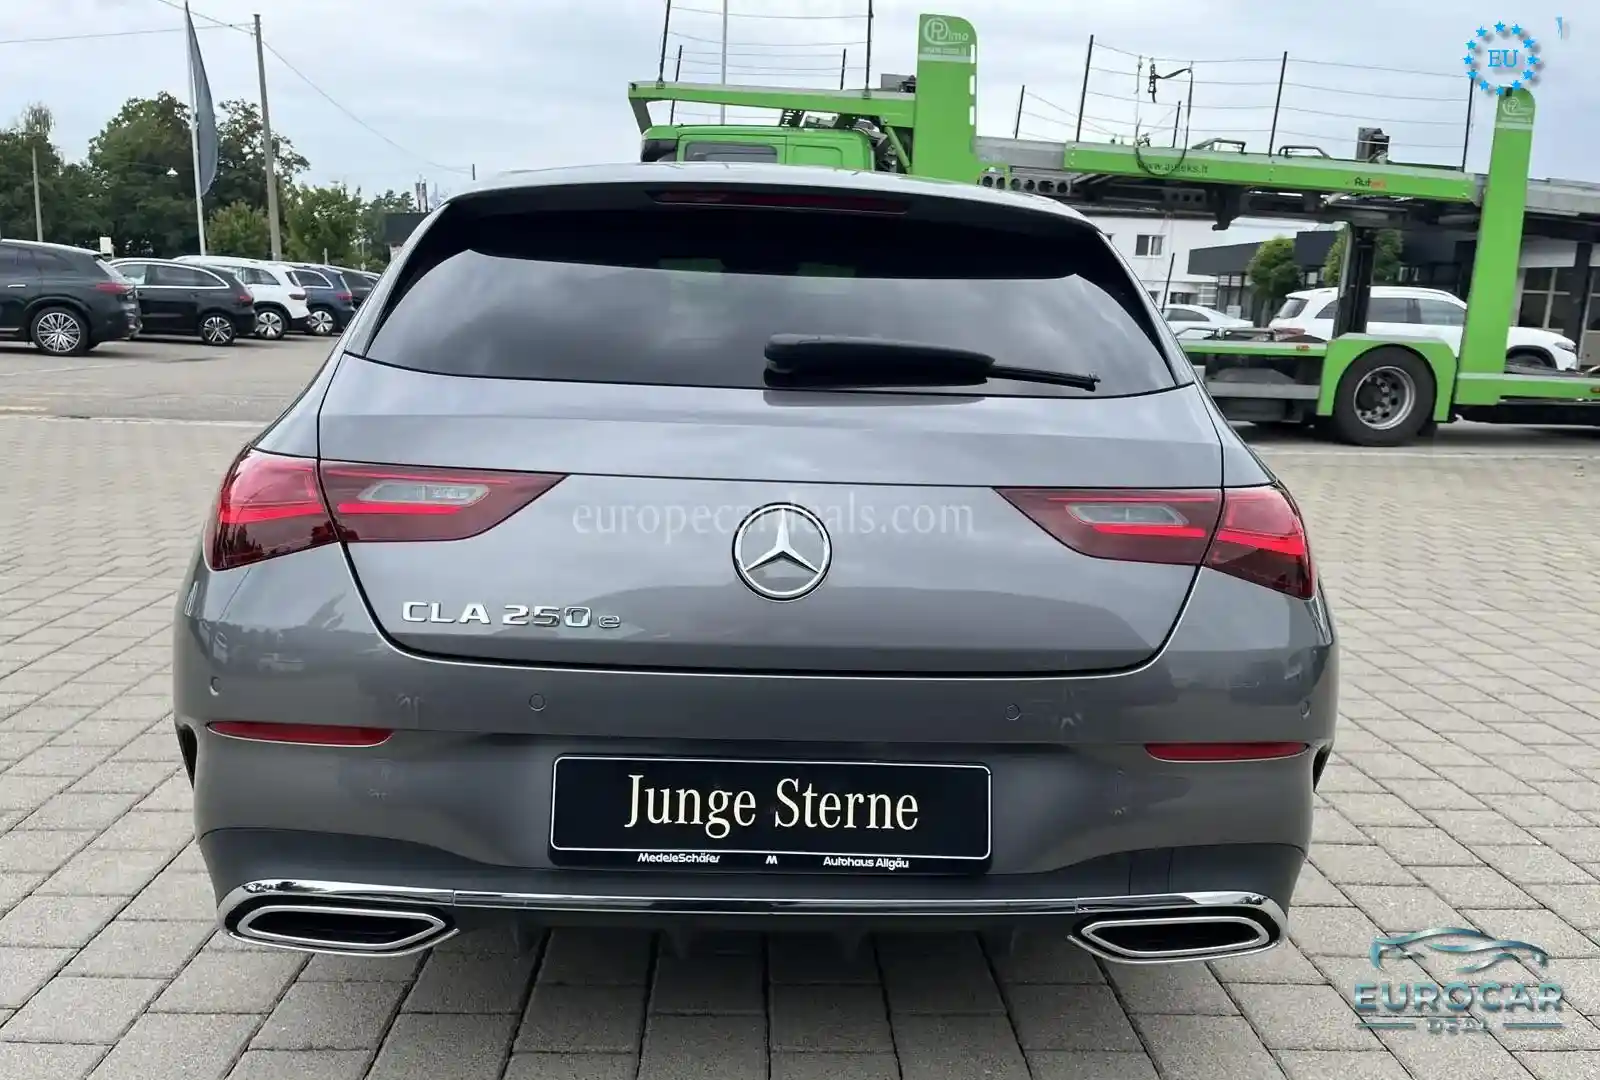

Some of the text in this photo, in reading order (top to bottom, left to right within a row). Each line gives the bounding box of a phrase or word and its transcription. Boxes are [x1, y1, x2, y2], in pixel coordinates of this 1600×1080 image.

[402, 601, 621, 629] CLA 250 e
[624, 774, 919, 839] Junge Sterne
[637, 852, 721, 864] MedeleSchäfer
[823, 856, 874, 867] Autohaus
[875, 857, 909, 870] Allgäu
